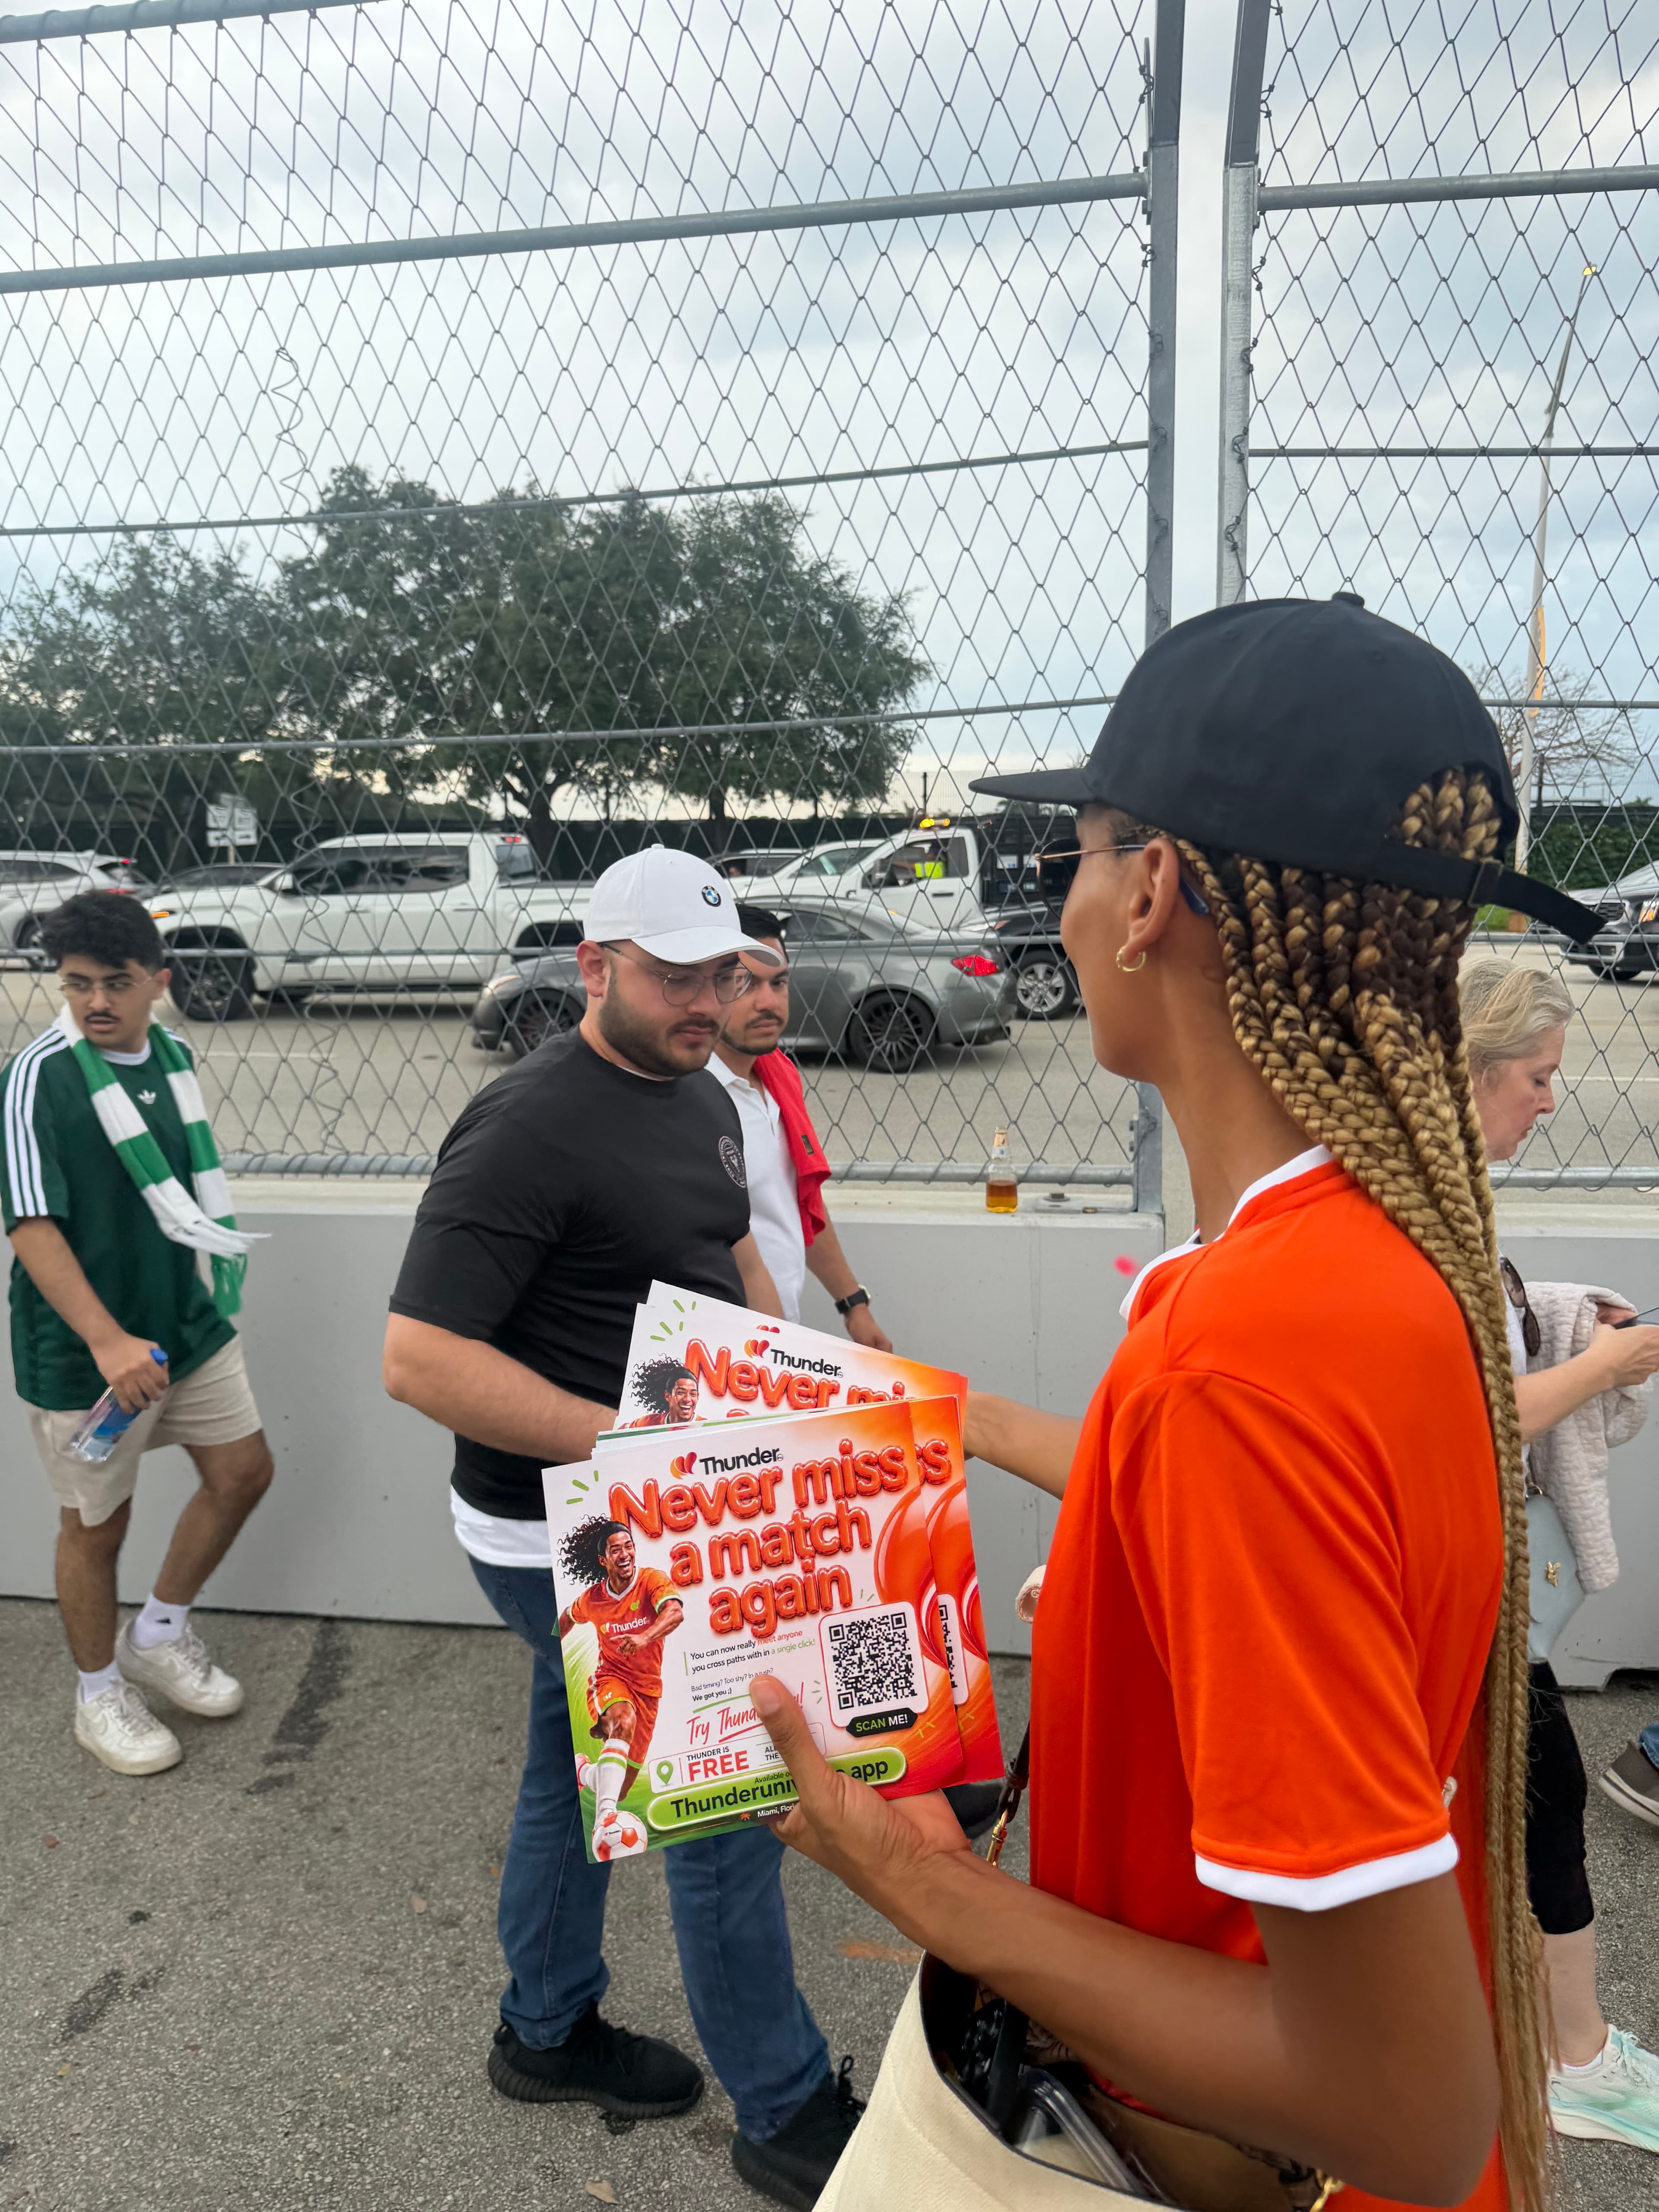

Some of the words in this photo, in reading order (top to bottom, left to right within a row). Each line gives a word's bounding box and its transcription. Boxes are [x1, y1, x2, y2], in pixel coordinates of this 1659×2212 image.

[684, 1338, 840, 1410] Never
[770, 1349, 841, 1376] Thunder
[699, 1447, 779, 1475] Thunder
[609, 1466, 782, 1538] Never
[792, 1438, 908, 1507] miss
[670, 1541, 703, 1586] a
[708, 1497, 872, 1579] match
[709, 1557, 853, 1639] again
[611, 1617, 647, 1634] Thunder
[721, 1645, 735, 1653] now
[737, 1640, 756, 1649] really
[758, 1636, 776, 1645] meet
[778, 1630, 802, 1641] anyone
[692, 1665, 705, 1674] you
[707, 1660, 725, 1669] cross
[727, 1655, 746, 1666] paths
[747, 1650, 762, 1659] with
[777, 1643, 796, 1653] single
[798, 1639, 815, 1648] click!
[703, 1679, 722, 1689] timing?
[735, 1674, 747, 1682] shy?
[704, 1692, 714, 1700] got
[686, 1715, 710, 1745] Try
[717, 1707, 756, 1735] Thund
[855, 1718, 886, 1732] SCAN
[888, 1714, 908, 1727] ME!
[687, 1748, 721, 1761] THUNDER
[688, 1750, 749, 1782] FREE
[765, 1753, 779, 1761] THE
[755, 1772, 784, 1783] Available
[757, 1807, 779, 1818] Miami,
[781, 1803, 794, 1812] Flori
